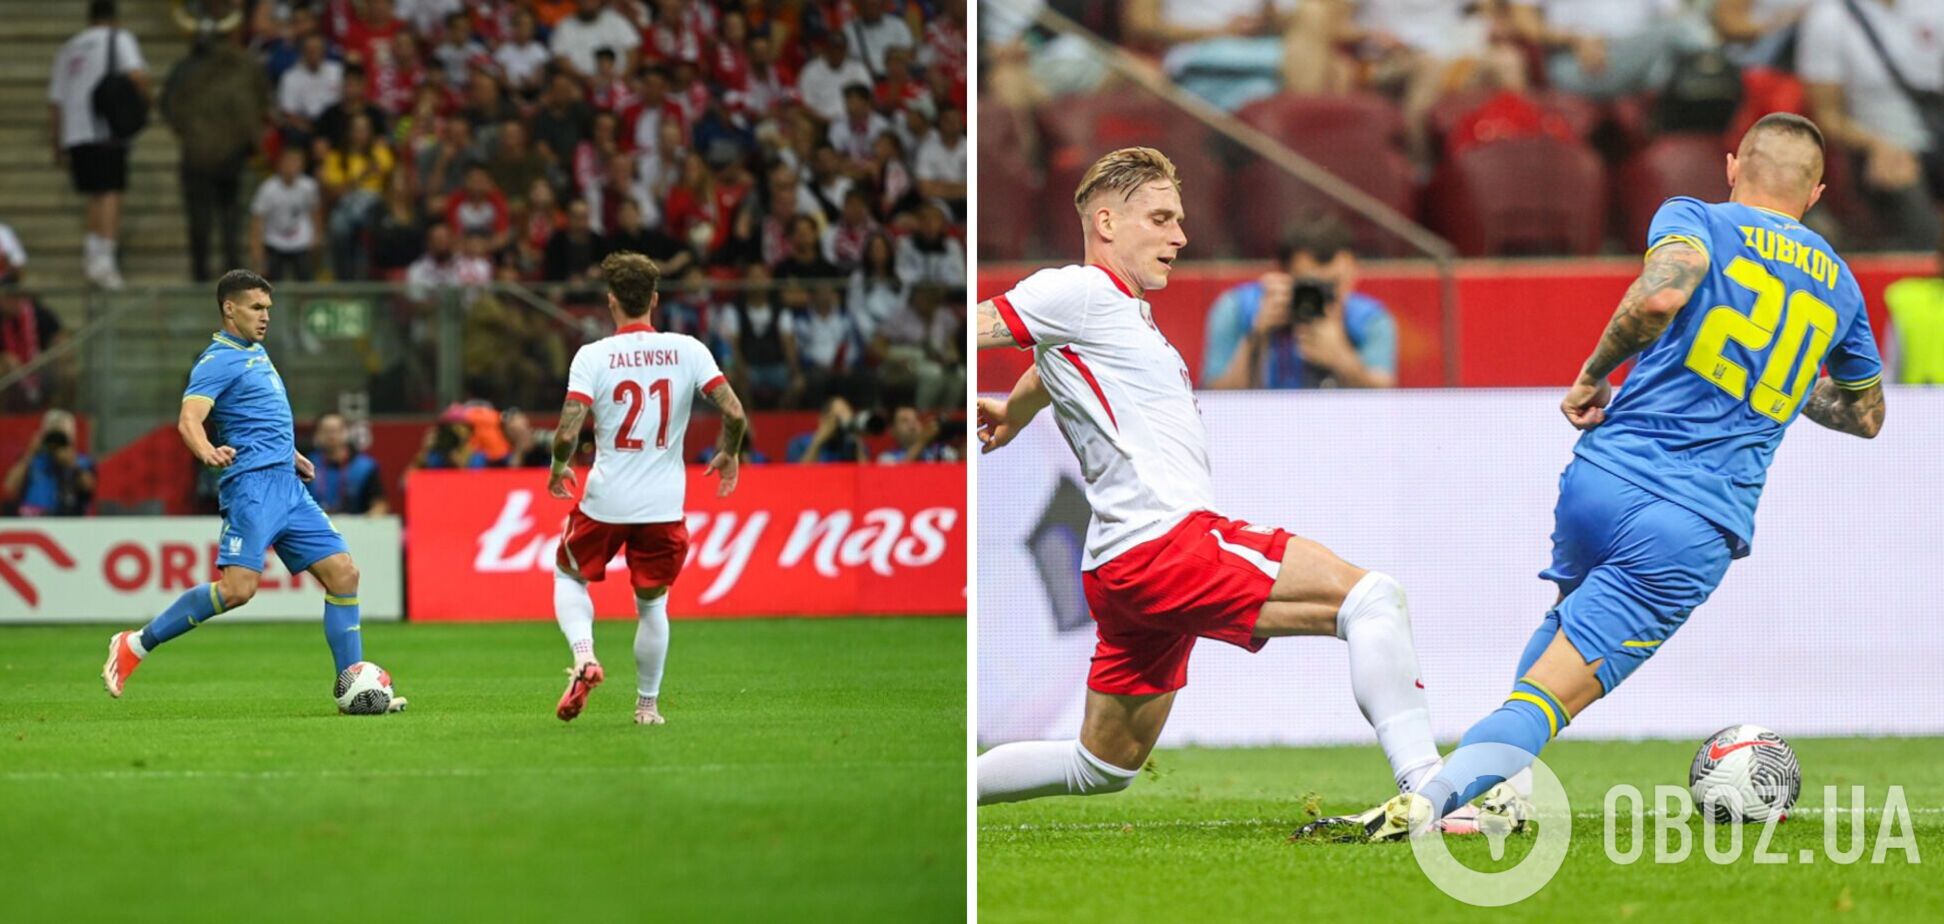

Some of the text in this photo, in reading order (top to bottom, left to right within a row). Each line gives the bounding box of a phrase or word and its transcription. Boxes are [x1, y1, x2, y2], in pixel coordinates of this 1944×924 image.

[1738, 225, 1839, 290] ZUBKOV
[609, 349, 679, 369] ZALEWSKI
[1683, 255, 1838, 425] 20
[613, 378, 672, 452] 21
[777, 506, 957, 578] nas
